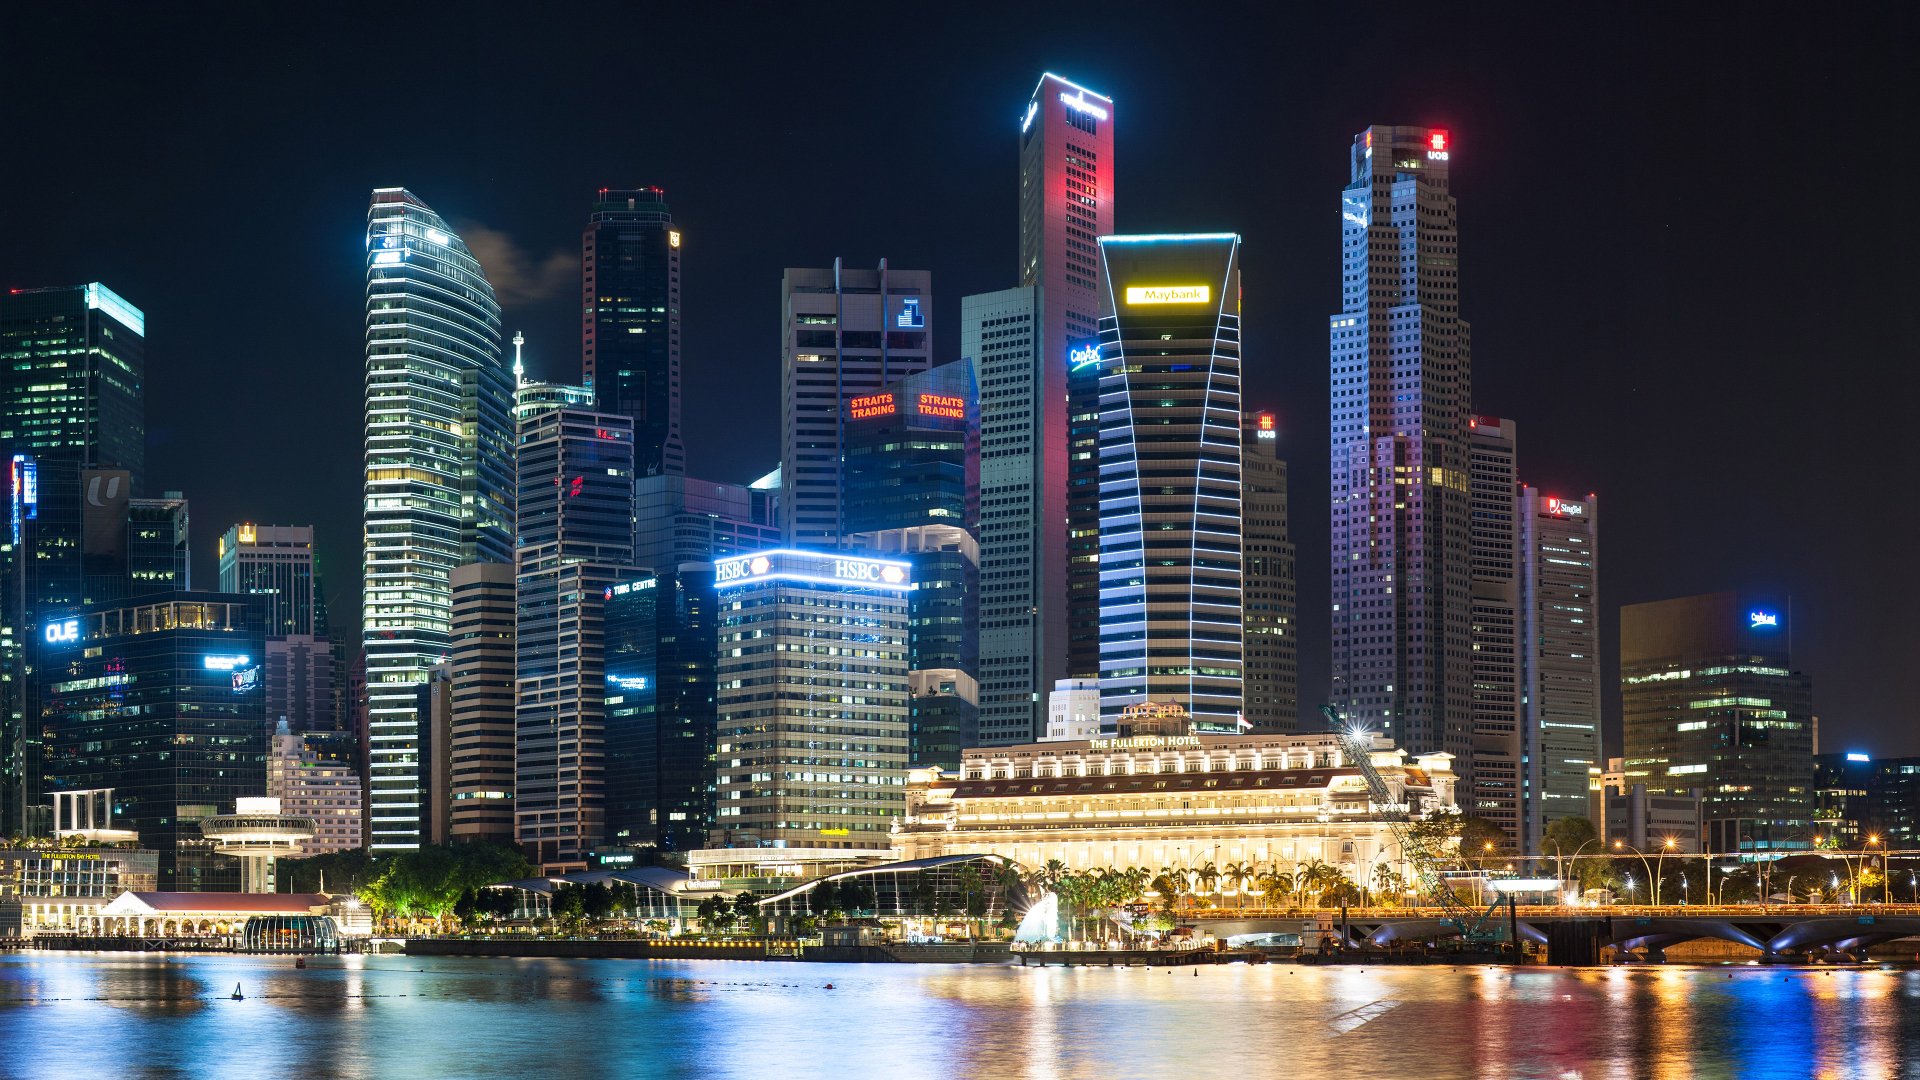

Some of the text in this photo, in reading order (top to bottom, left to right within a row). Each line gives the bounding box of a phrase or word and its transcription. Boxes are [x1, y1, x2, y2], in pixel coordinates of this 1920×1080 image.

[1428, 151, 1448, 160] UOB
[1145, 289, 1201, 301] Maybank
[852, 394, 893, 408] STRAITS
[921, 395, 964, 407] STRAITS
[852, 405, 895, 418] TRADING
[919, 405, 963, 418] TRADING
[716, 560, 750, 581] HSBC
[835, 560, 880, 580] HSBC
[614, 578, 656, 595] TUNG CENTRE
[46, 621, 79, 641] OUE
[1090, 736, 1200, 748] THE FULLERTON HOTEL
